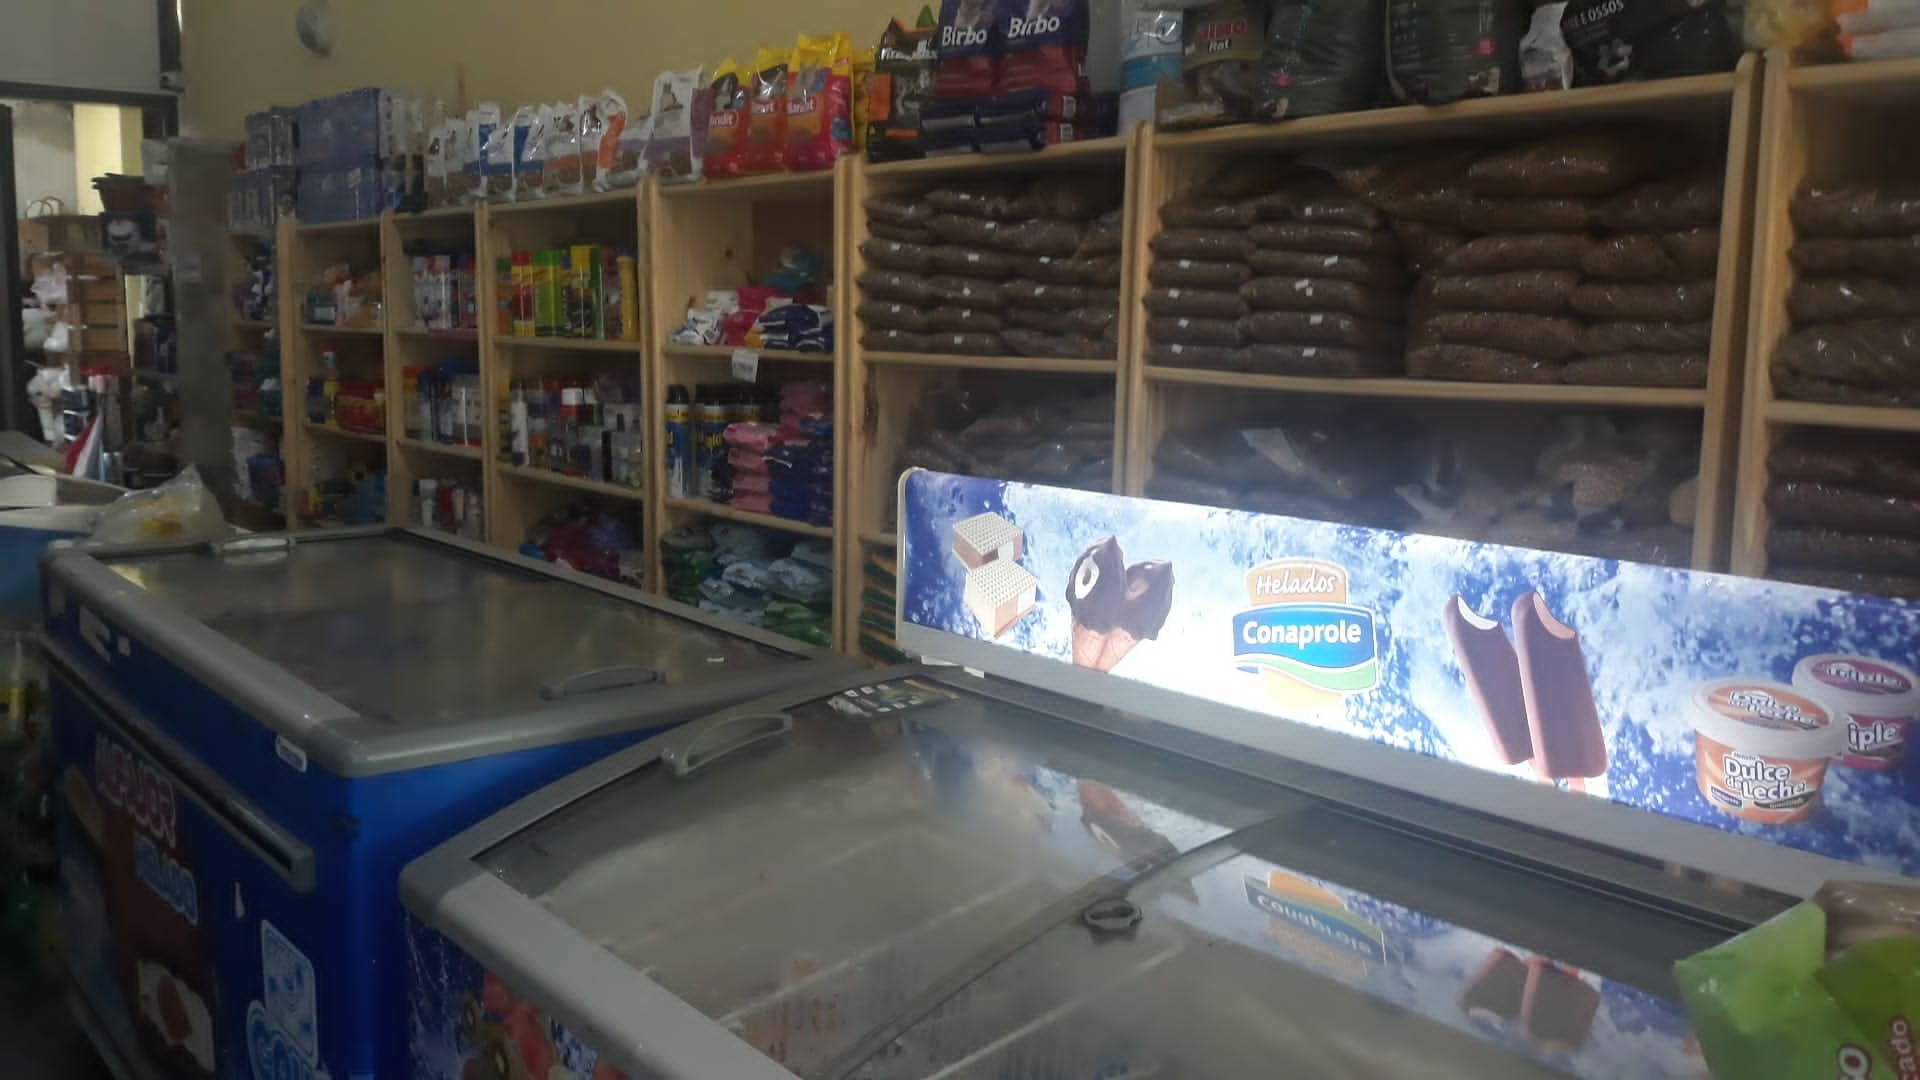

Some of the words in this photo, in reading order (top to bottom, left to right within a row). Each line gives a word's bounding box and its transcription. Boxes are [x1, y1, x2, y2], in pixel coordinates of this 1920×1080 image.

[942, 25, 987, 46] Birbo
[1007, 15, 1060, 38] Birbo
[1256, 567, 1335, 596] Helados
[1243, 619, 1361, 650] Conaprole
[1848, 722, 1897, 751] iple
[1724, 756, 1789, 780] Dulce
[1741, 780, 1805, 801] Leche
